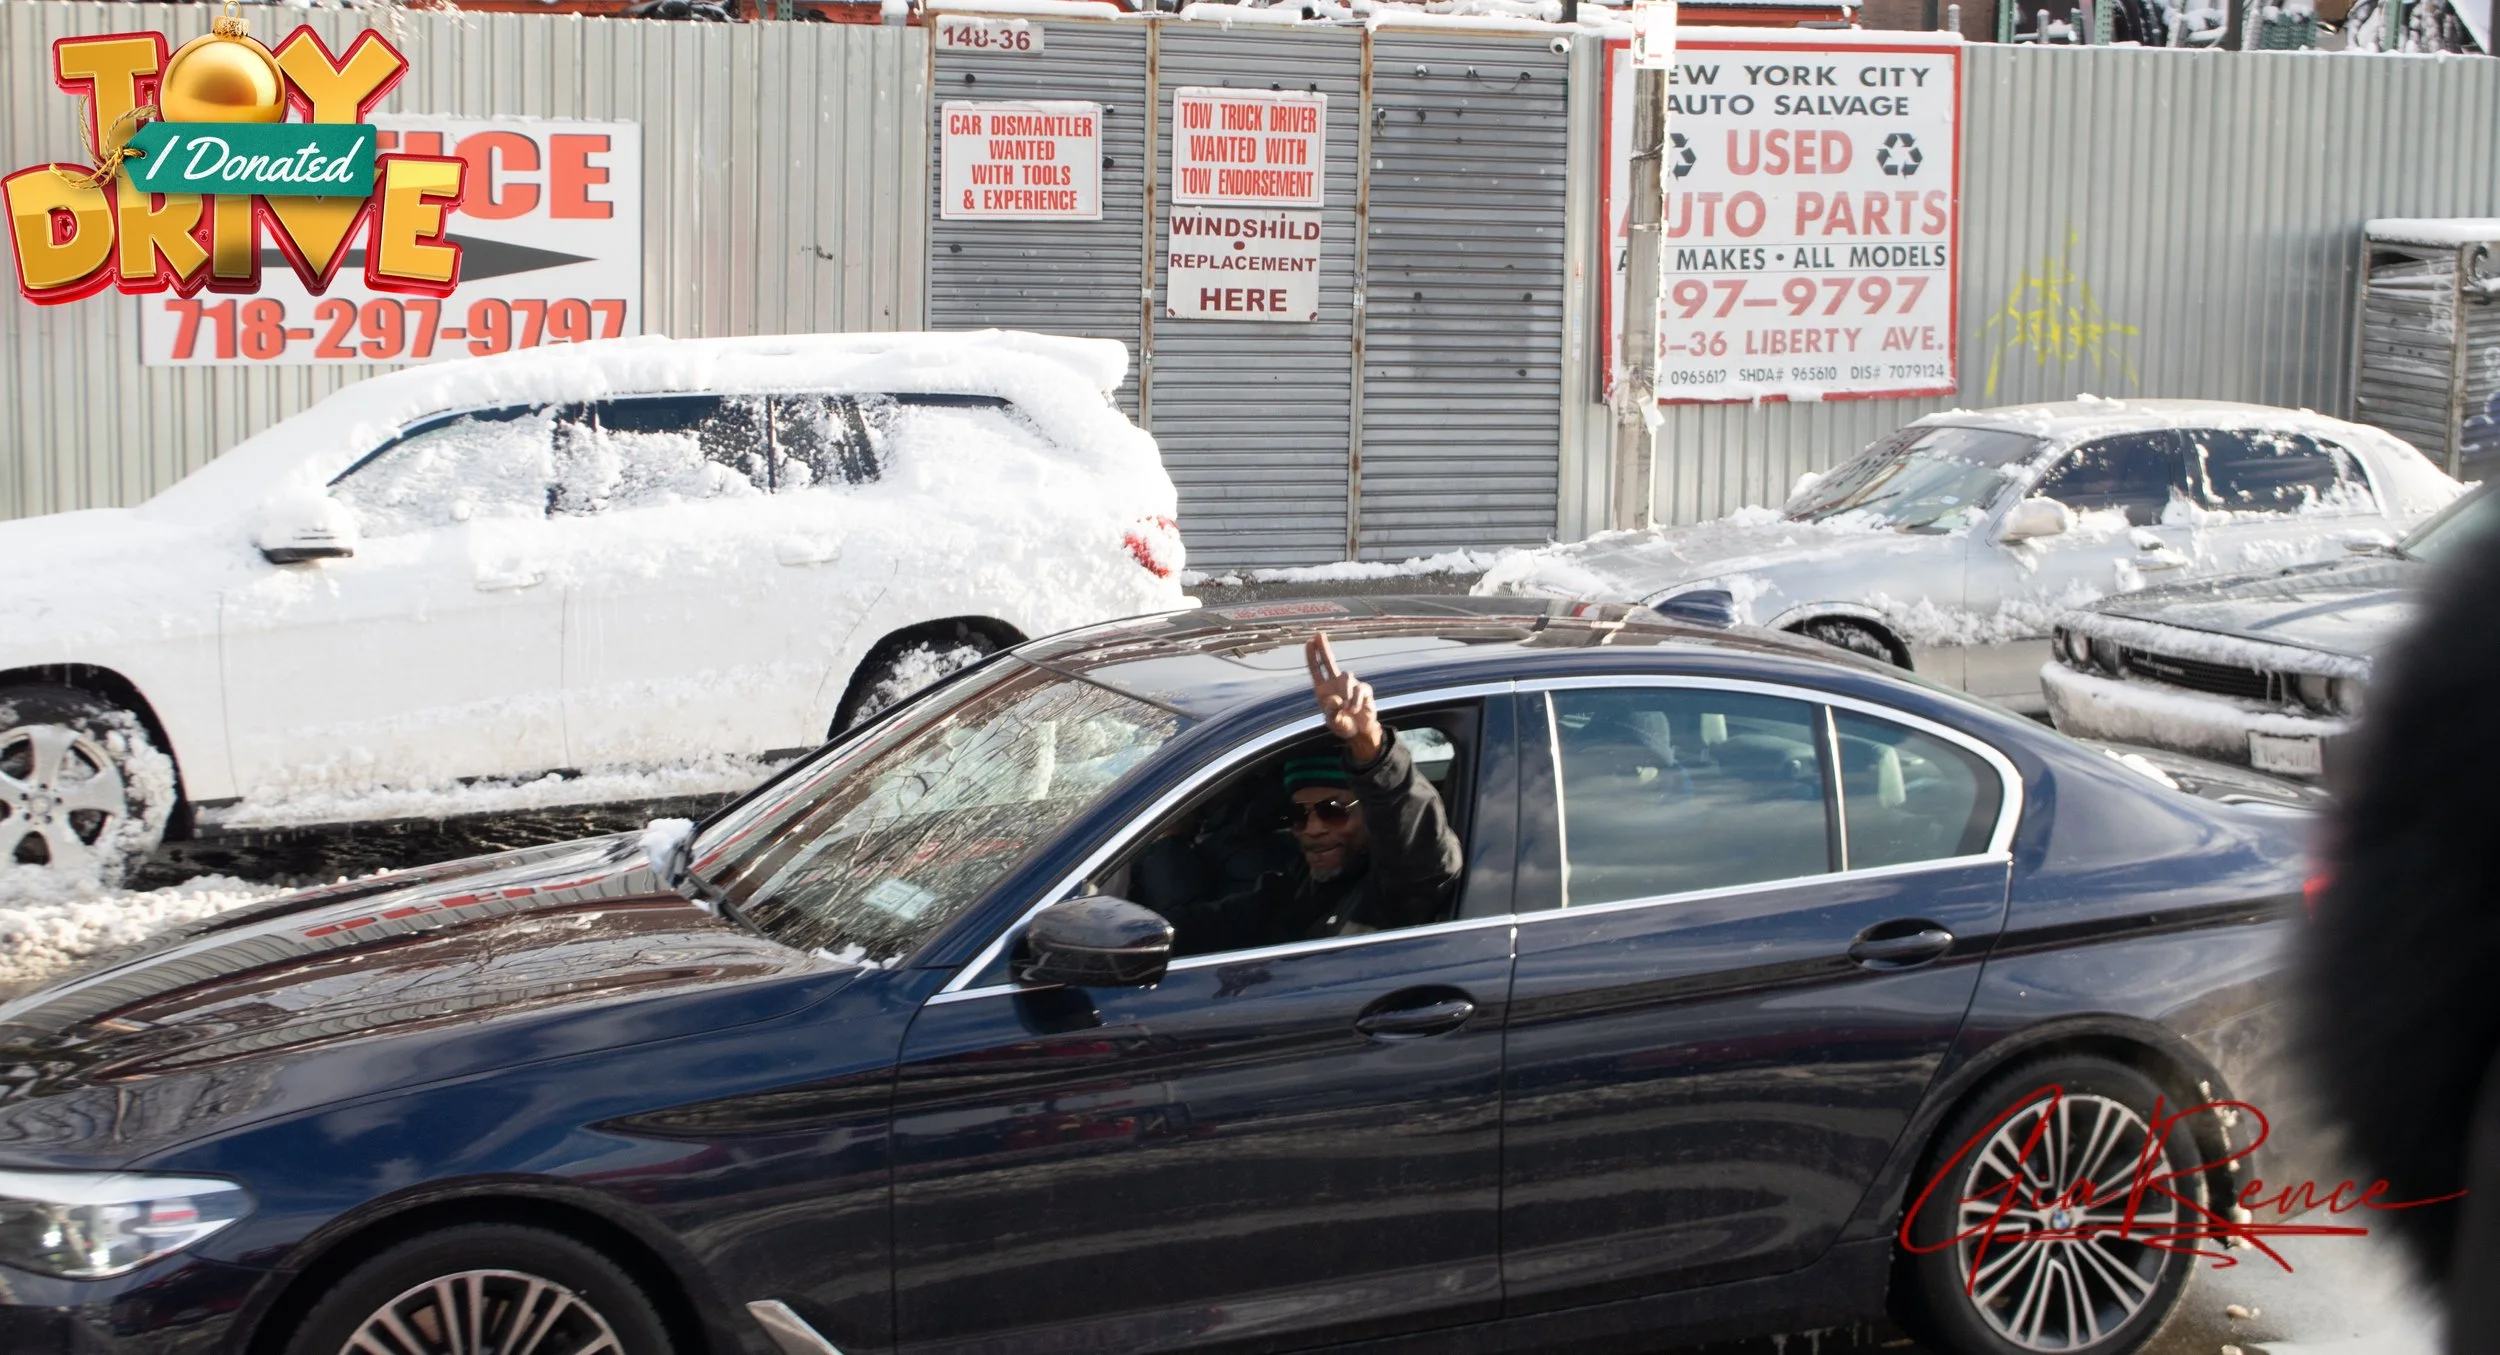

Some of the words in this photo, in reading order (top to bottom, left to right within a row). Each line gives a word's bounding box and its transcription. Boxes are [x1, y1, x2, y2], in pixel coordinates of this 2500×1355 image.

[943, 26, 1031, 51] 148-36
[1668, 64, 1720, 85] EW
[1743, 65, 1837, 86] YORK
[1859, 66, 1931, 87] CITY
[1181, 101, 1213, 131] TOW
[1219, 103, 1264, 132] TRUCK
[1269, 105, 1318, 134] DRIVER
[1667, 94, 1755, 116] AUTO
[1774, 94, 1909, 116] SALVAGE
[950, 114, 982, 136] CAR
[990, 115, 1093, 138] DISMANTLER
[988, 139, 1056, 161] WANTED
[1190, 134, 1257, 164] WANTED
[1265, 137, 1307, 166] WITH
[1726, 128, 1853, 176] USED
[971, 164, 1014, 186] WITH
[1022, 164, 1071, 186] TOOLS
[1181, 167, 1212, 195] TOW
[1218, 168, 1314, 198] ENDORSEMENT
[962, 189, 976, 210] &
[983, 189, 1078, 211] EXPERIENCE
[1794, 190, 1947, 236] PARTS
[1169, 253, 1317, 272] REPLACEMENT
[1676, 248, 1766, 271] MAKES
[1793, 247, 1835, 269] ALL
[1849, 245, 1946, 268] MODELS
[1200, 287, 1287, 312] HERE
[1660, 276, 1930, 319] 97-9797
[166, 298, 627, 360] 718-297-9797
[1745, 327, 1862, 355] LIBERTY
[1881, 326, 1944, 351] AVE.
[1739, 368, 1784, 382] SHDA#
[1791, 366, 1837, 381] 965610
[1850, 365, 1881, 380] DIS#
[1888, 363, 1945, 379] 7079124
